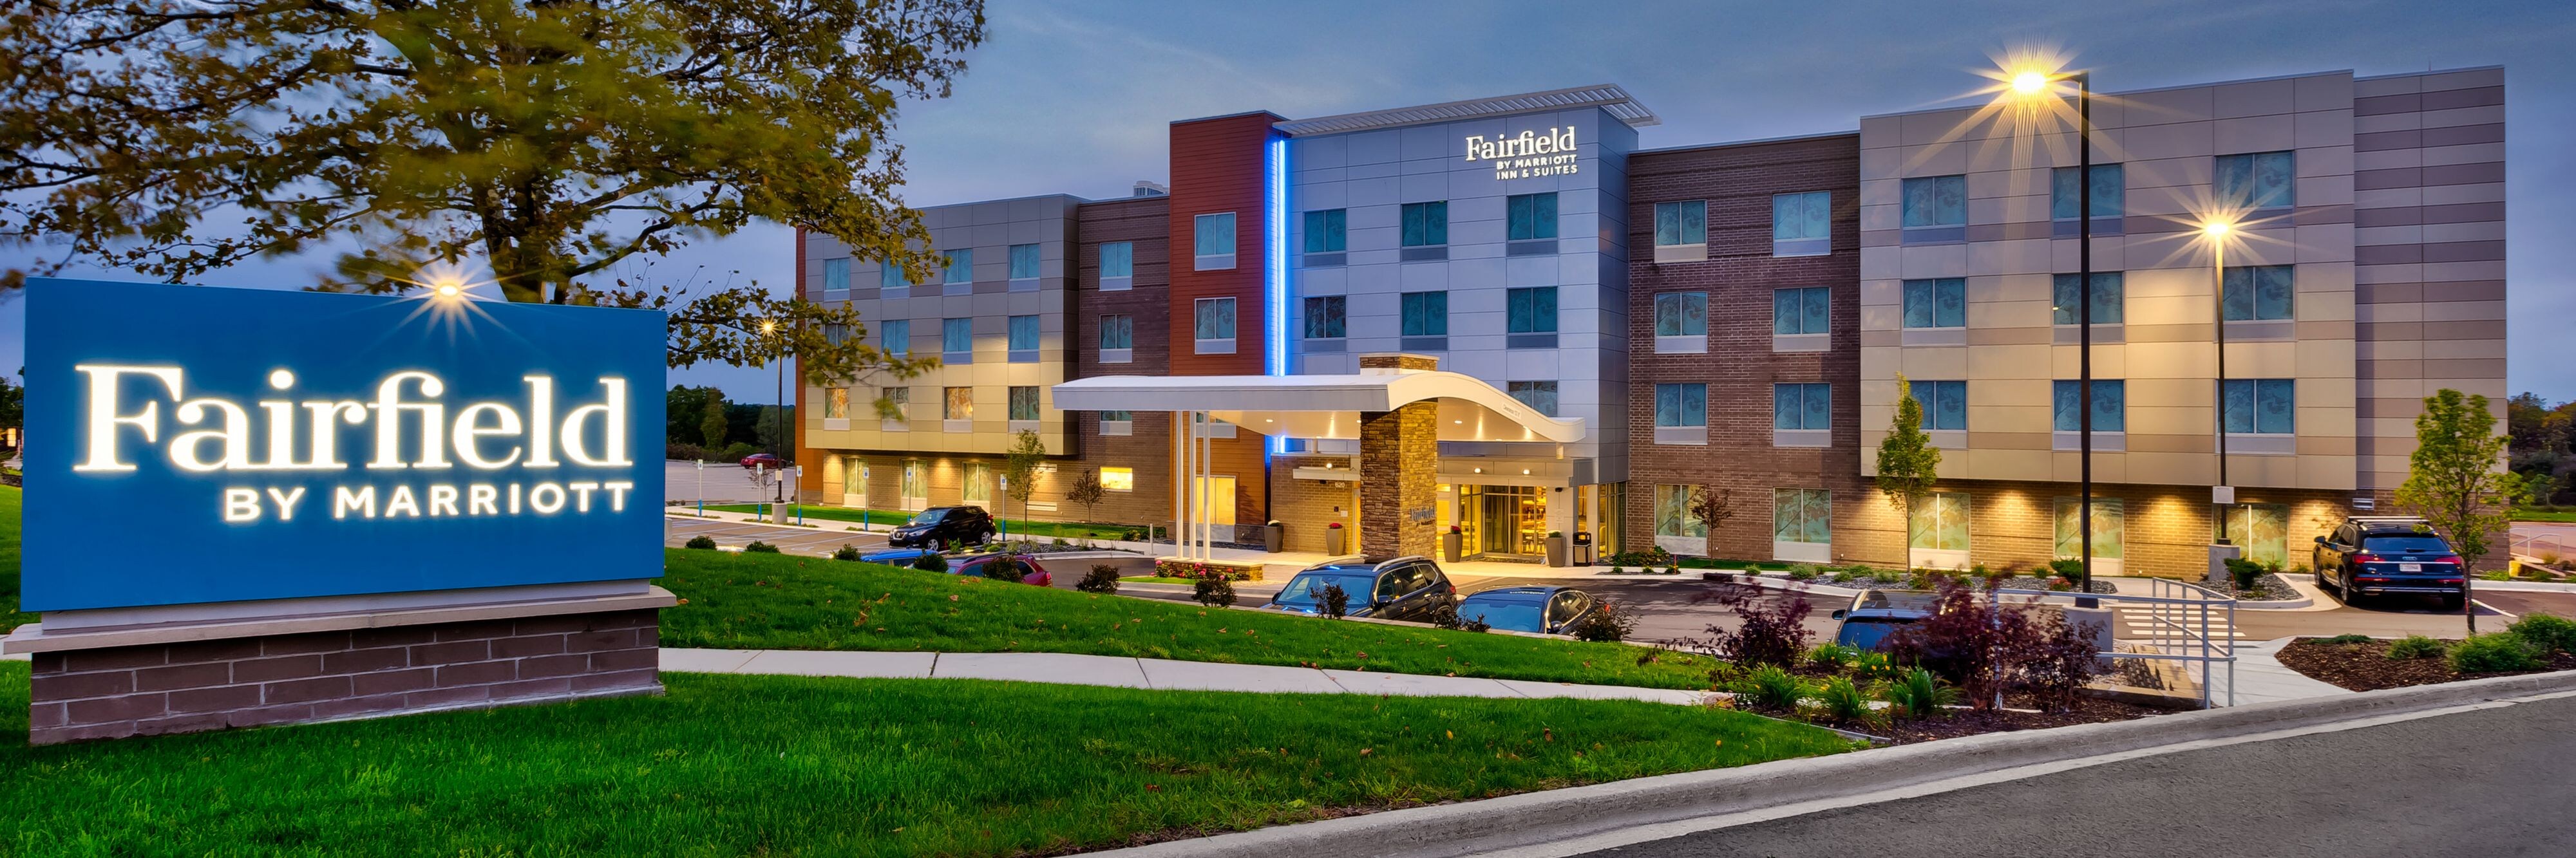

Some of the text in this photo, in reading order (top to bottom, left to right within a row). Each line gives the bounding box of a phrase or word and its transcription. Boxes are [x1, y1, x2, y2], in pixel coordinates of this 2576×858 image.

[1466, 126, 1577, 161] Fairfield
[1496, 154, 1577, 170] BY MARRIOTT
[1496, 164, 1578, 180] INN & SUITES
[73, 364, 633, 472] Fairfield
[225, 481, 633, 522] BY MARRIOTT
